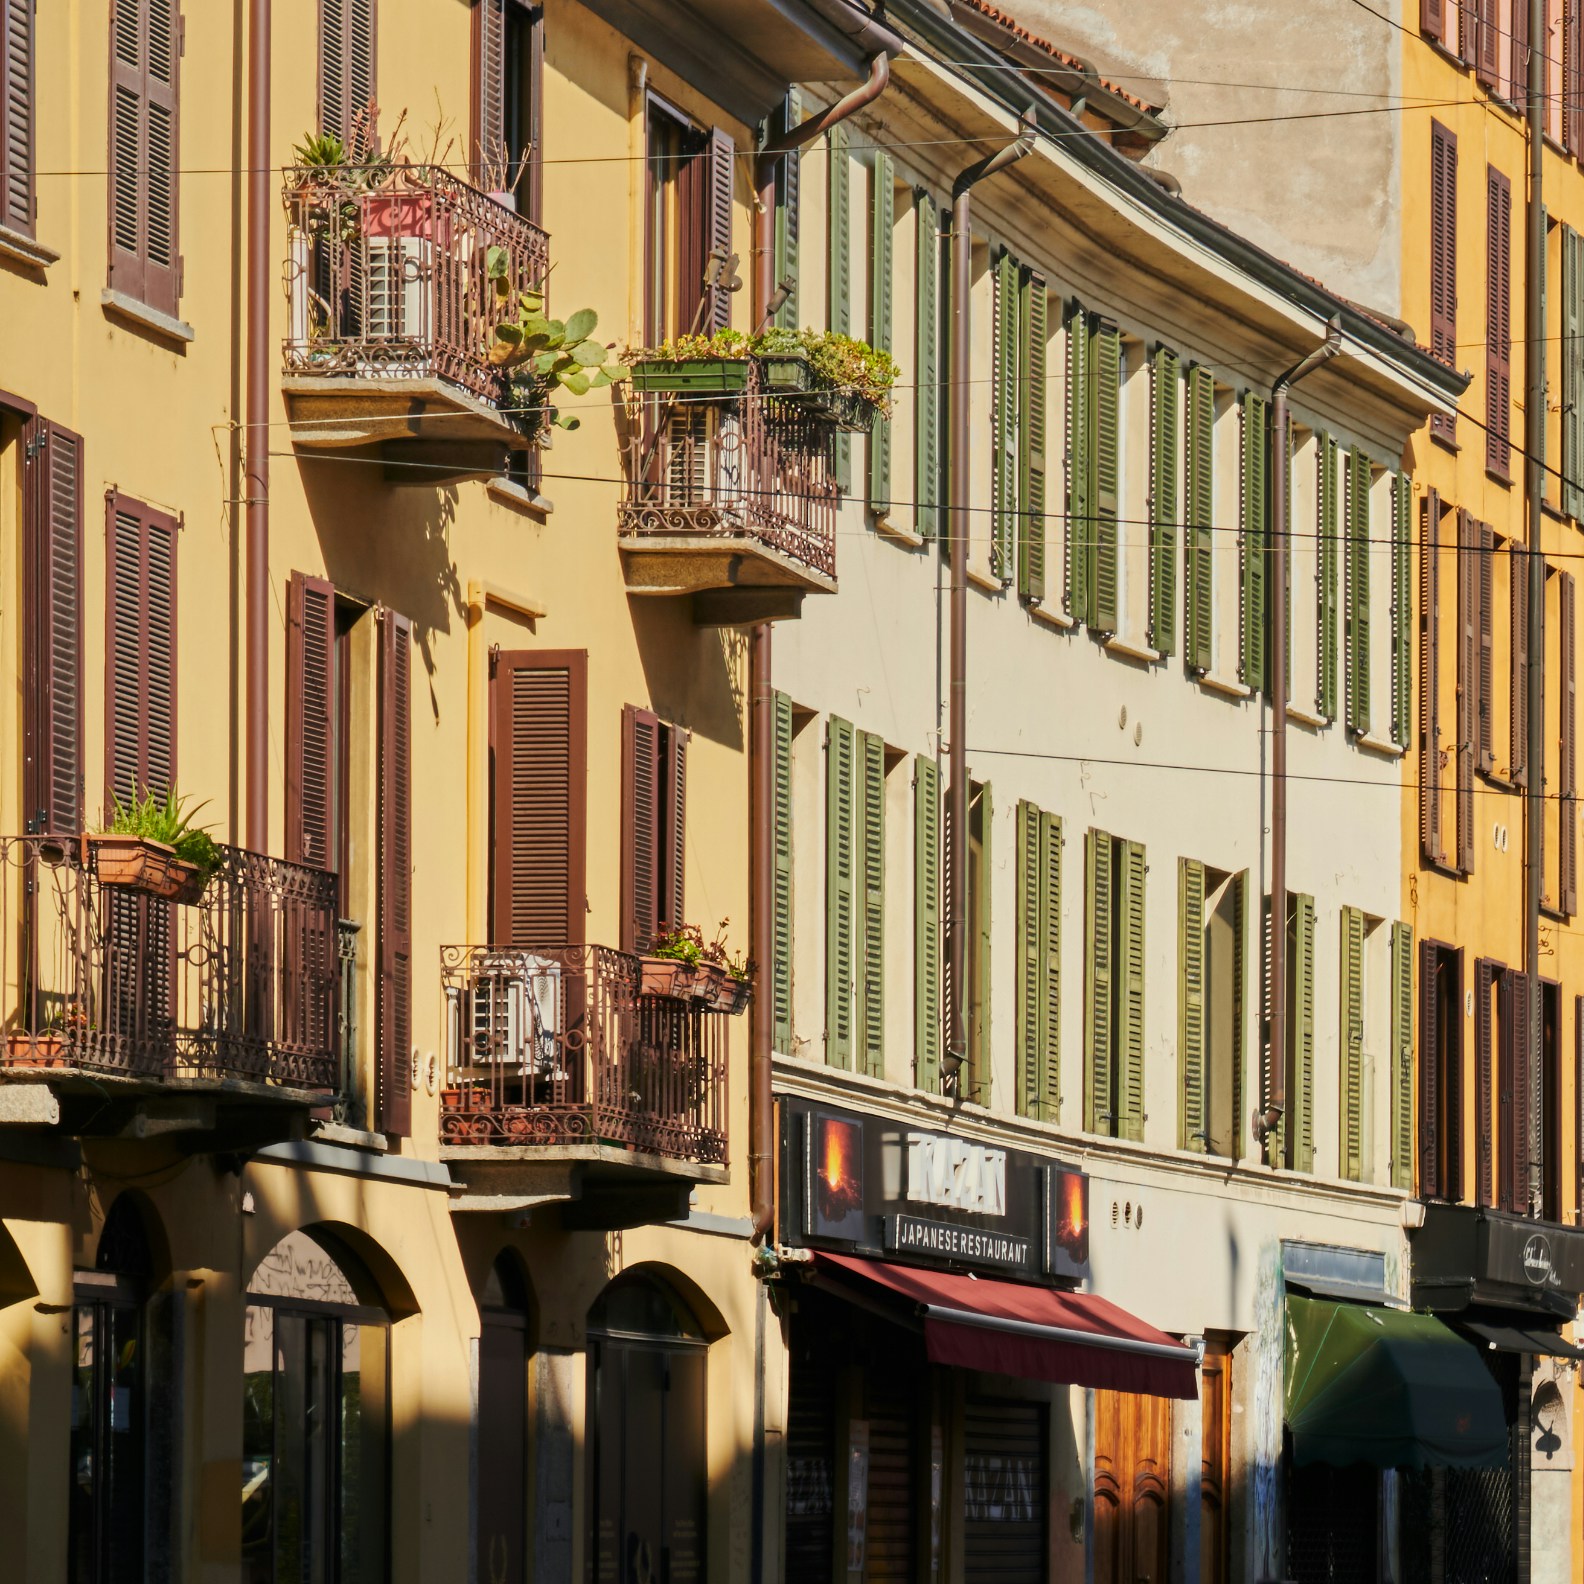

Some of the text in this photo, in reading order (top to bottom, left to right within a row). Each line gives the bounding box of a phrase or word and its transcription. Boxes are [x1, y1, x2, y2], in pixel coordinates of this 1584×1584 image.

[907, 1132, 1007, 1217] KAZAN
[901, 1222, 1028, 1264] JAPANESE RESTAURANT
